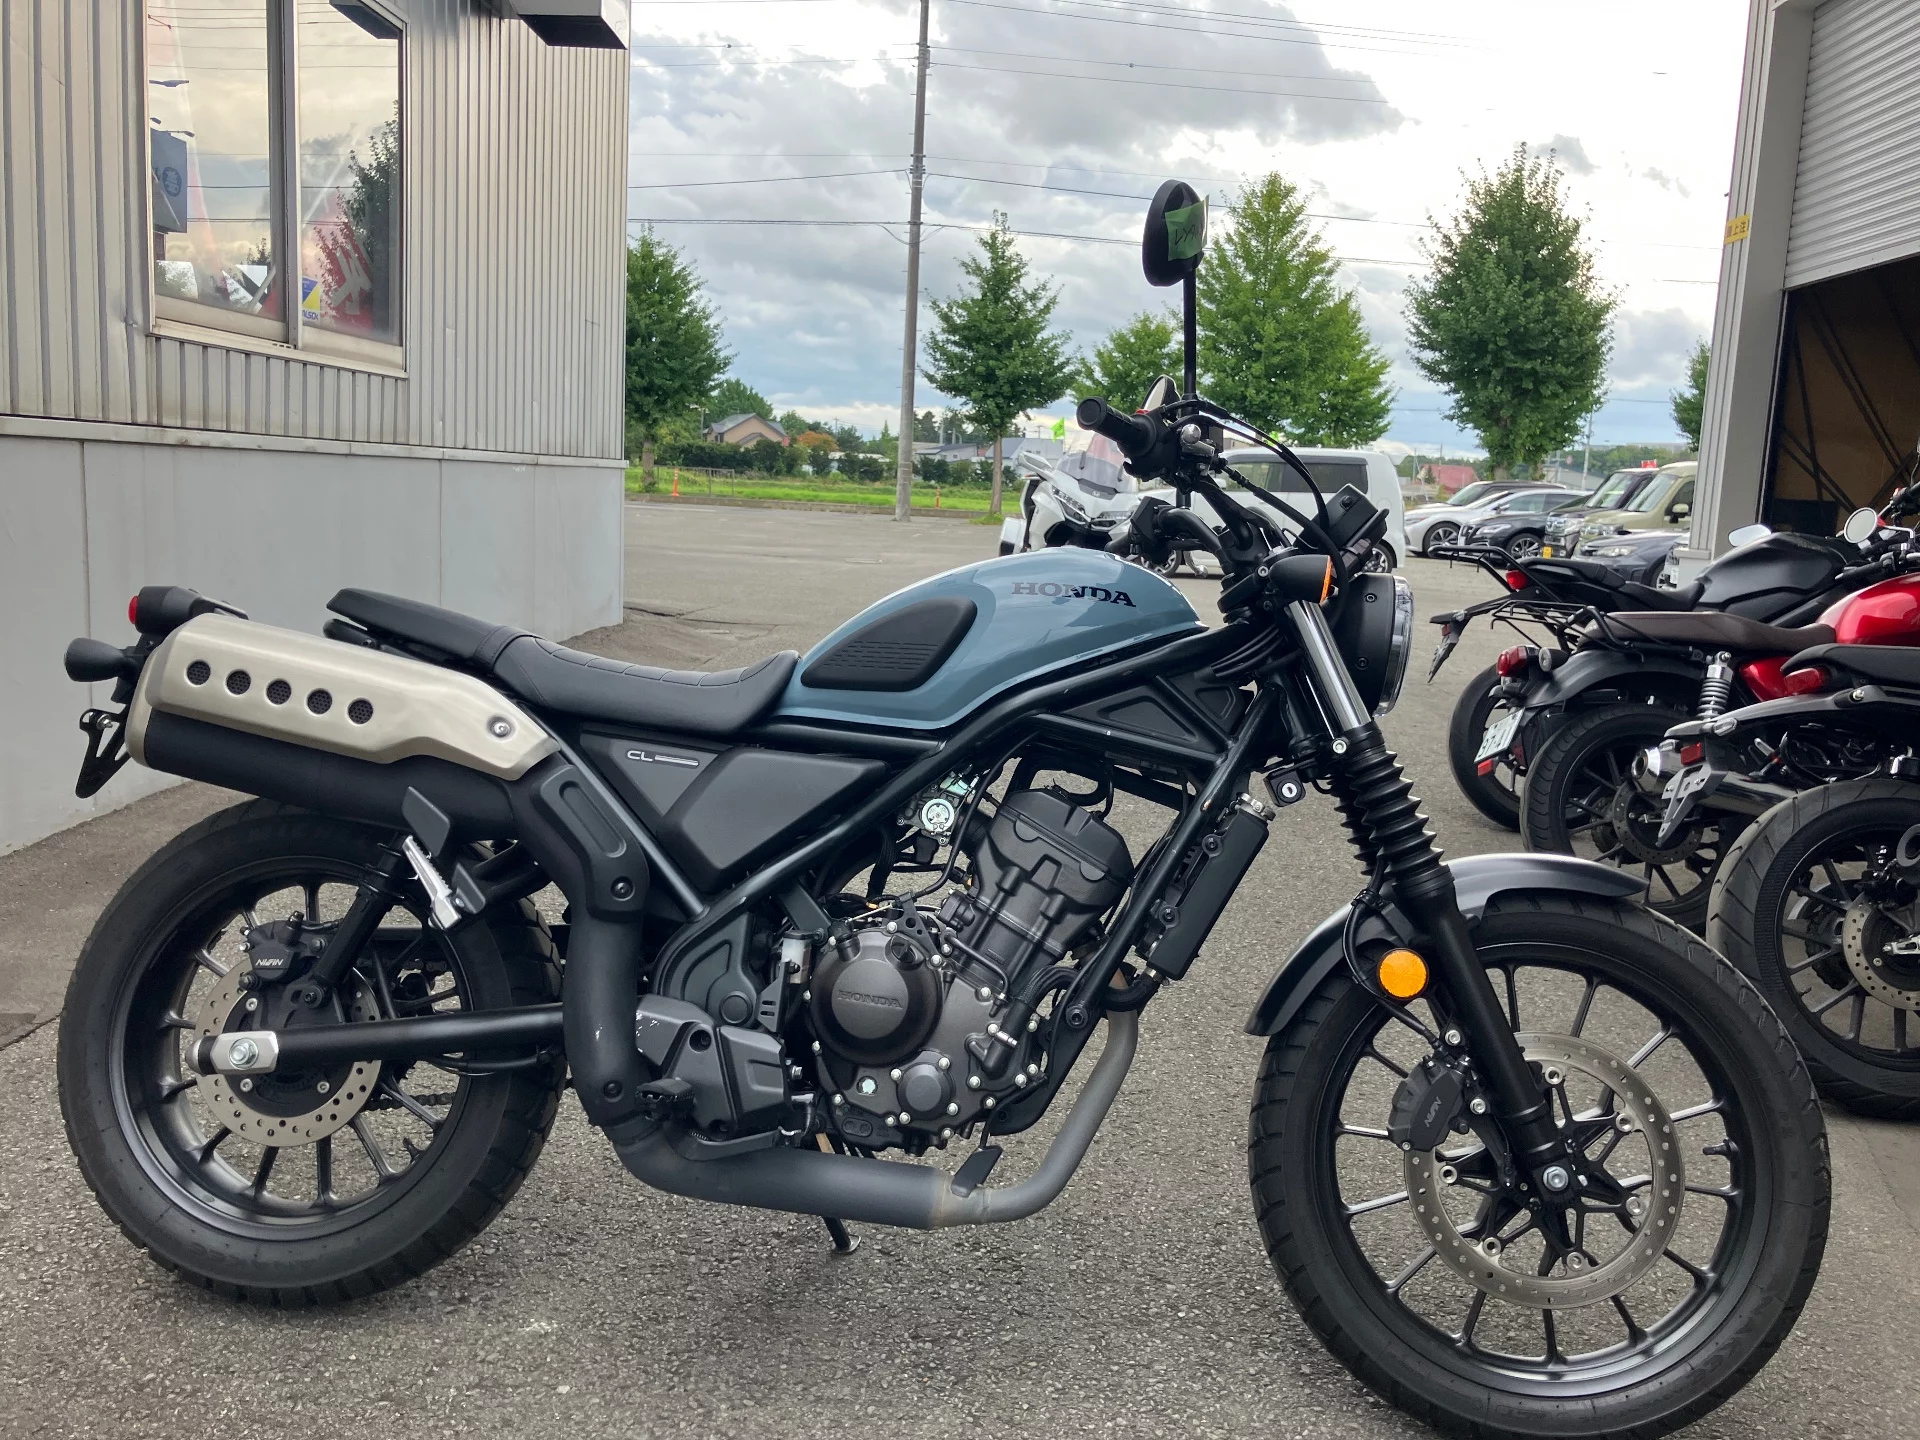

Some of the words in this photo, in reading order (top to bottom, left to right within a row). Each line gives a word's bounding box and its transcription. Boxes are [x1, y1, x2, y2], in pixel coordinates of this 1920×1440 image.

[1012, 581, 1137, 608] HONDA
[627, 750, 653, 762] CL
[837, 989, 903, 1010] HONDA
